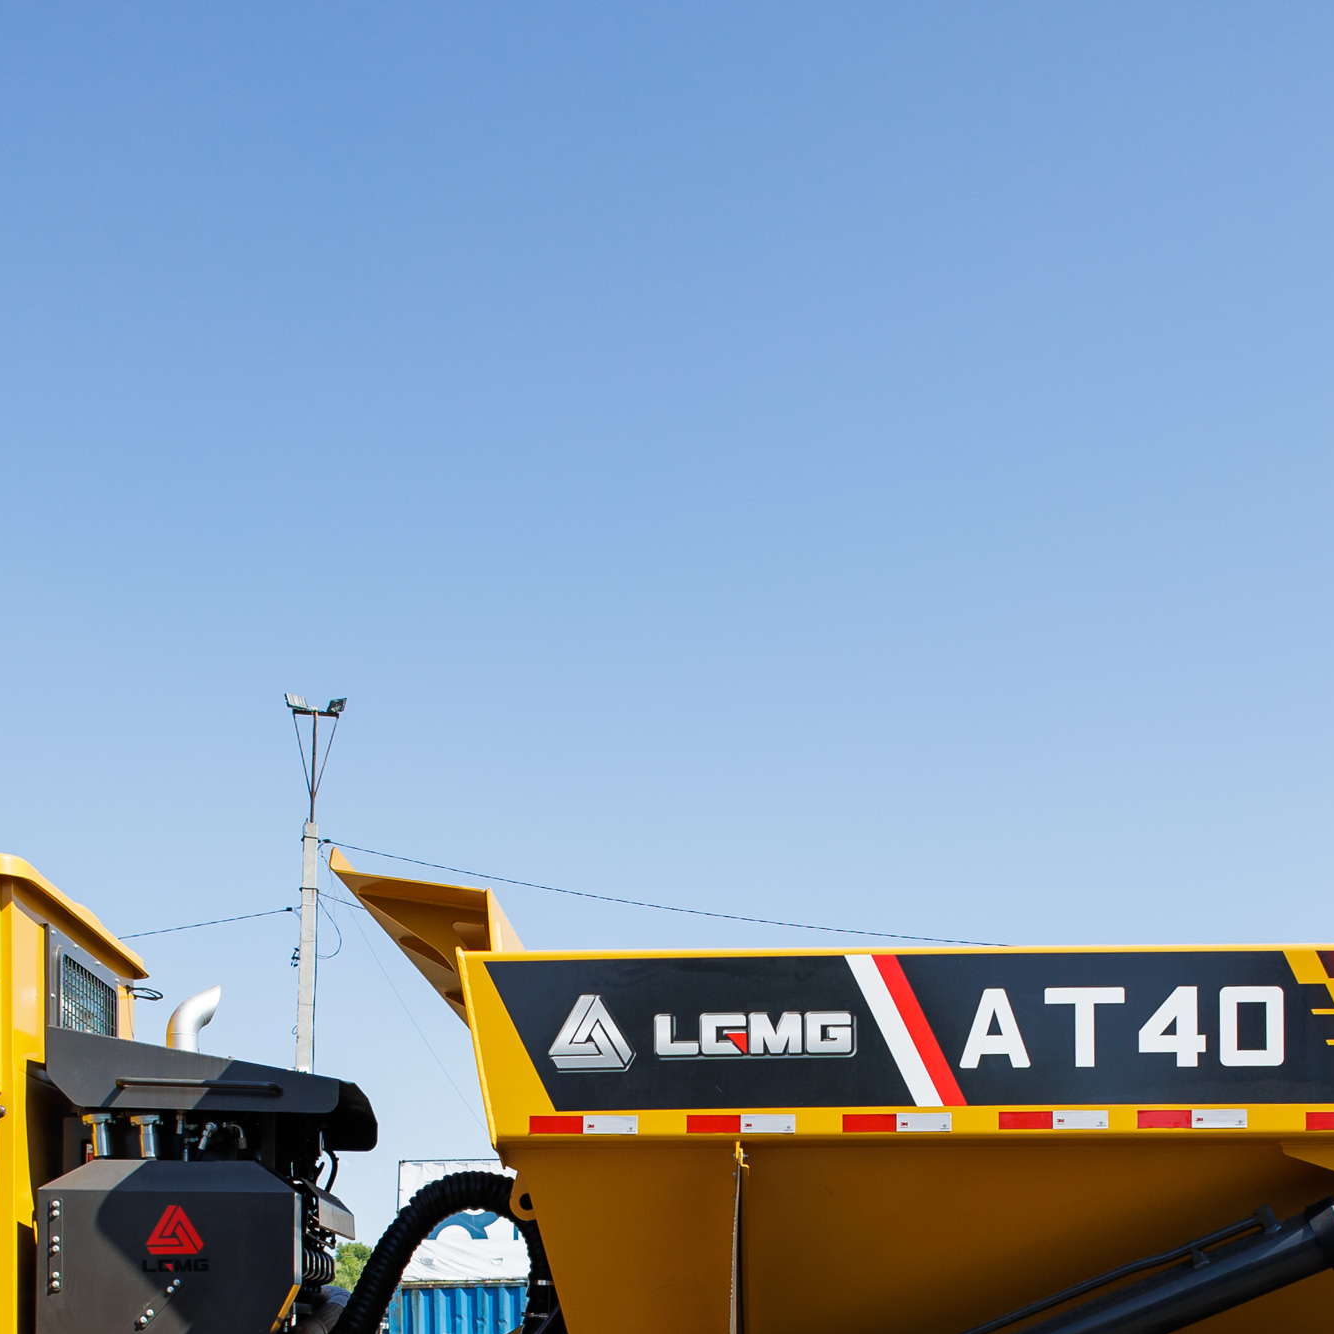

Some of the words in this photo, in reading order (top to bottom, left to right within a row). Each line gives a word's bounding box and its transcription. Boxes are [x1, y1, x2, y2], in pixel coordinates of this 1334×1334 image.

[654, 1011, 857, 1060] LGMG
[959, 985, 1285, 1069] AT40
[142, 1259, 209, 1273] LGMG
